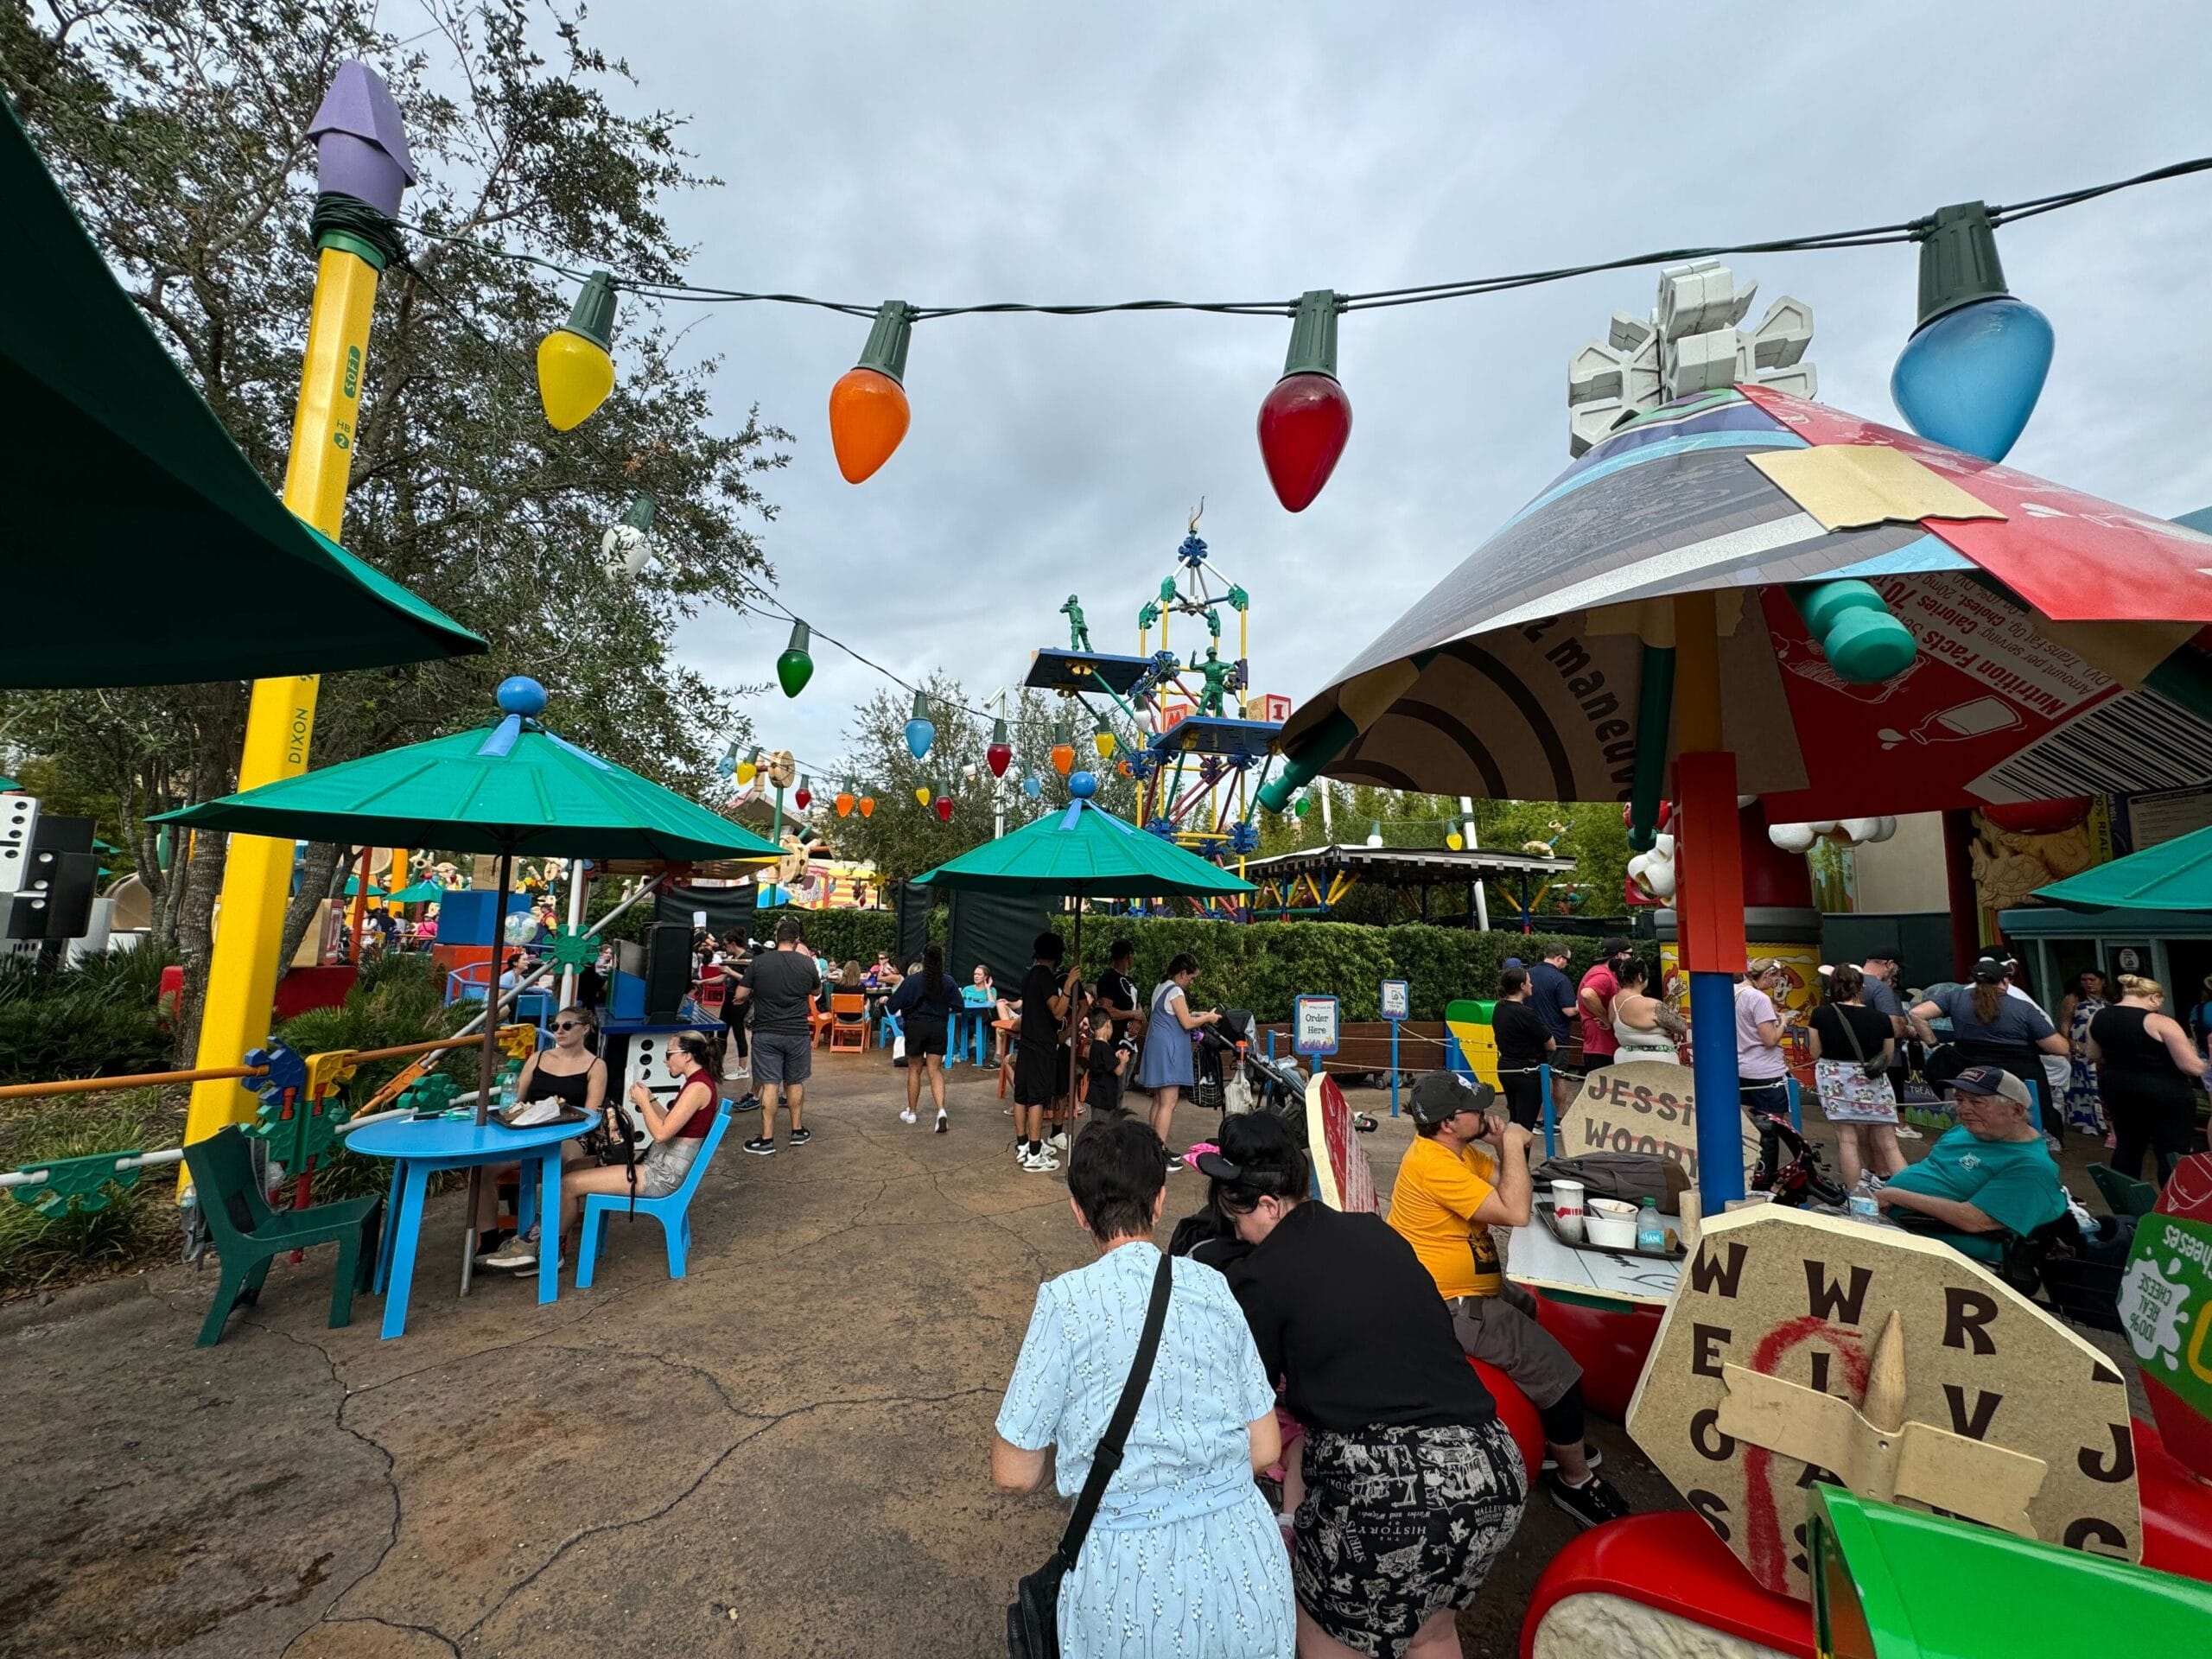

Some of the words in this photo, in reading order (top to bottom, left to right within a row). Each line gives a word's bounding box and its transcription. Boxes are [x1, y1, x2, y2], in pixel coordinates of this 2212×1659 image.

[346, 353, 359, 391] SOFT
[336, 419, 351, 433] HB
[1923, 575, 1957, 601] 20mg
[1917, 594, 1979, 635] Calories
[1958, 594, 2006, 627] Cholest.
[1922, 630, 1980, 669] Facts
[2024, 633, 2046, 650] Fat
[2044, 645, 2081, 670] Trans
[2022, 652, 2047, 669] per
[1976, 660, 2067, 715] Nutrition
[2041, 662, 2094, 696] Amount
[288, 708, 309, 764] DIXON
[1306, 1014, 1329, 1022] Order
[1693, 1238, 1749, 1298] W
[1803, 1260, 1873, 1325] W
[1943, 1287, 1999, 1355] R
[2138, 1273, 2172, 1306] CHEESE
[2139, 1295, 2161, 1323] REAL
[2130, 1313, 2157, 1343] 100%
[2078, 1423, 2135, 1483] J
[1345, 1521, 1367, 1562] SPIRITS
[1357, 1526, 1427, 1535] HISTORY
